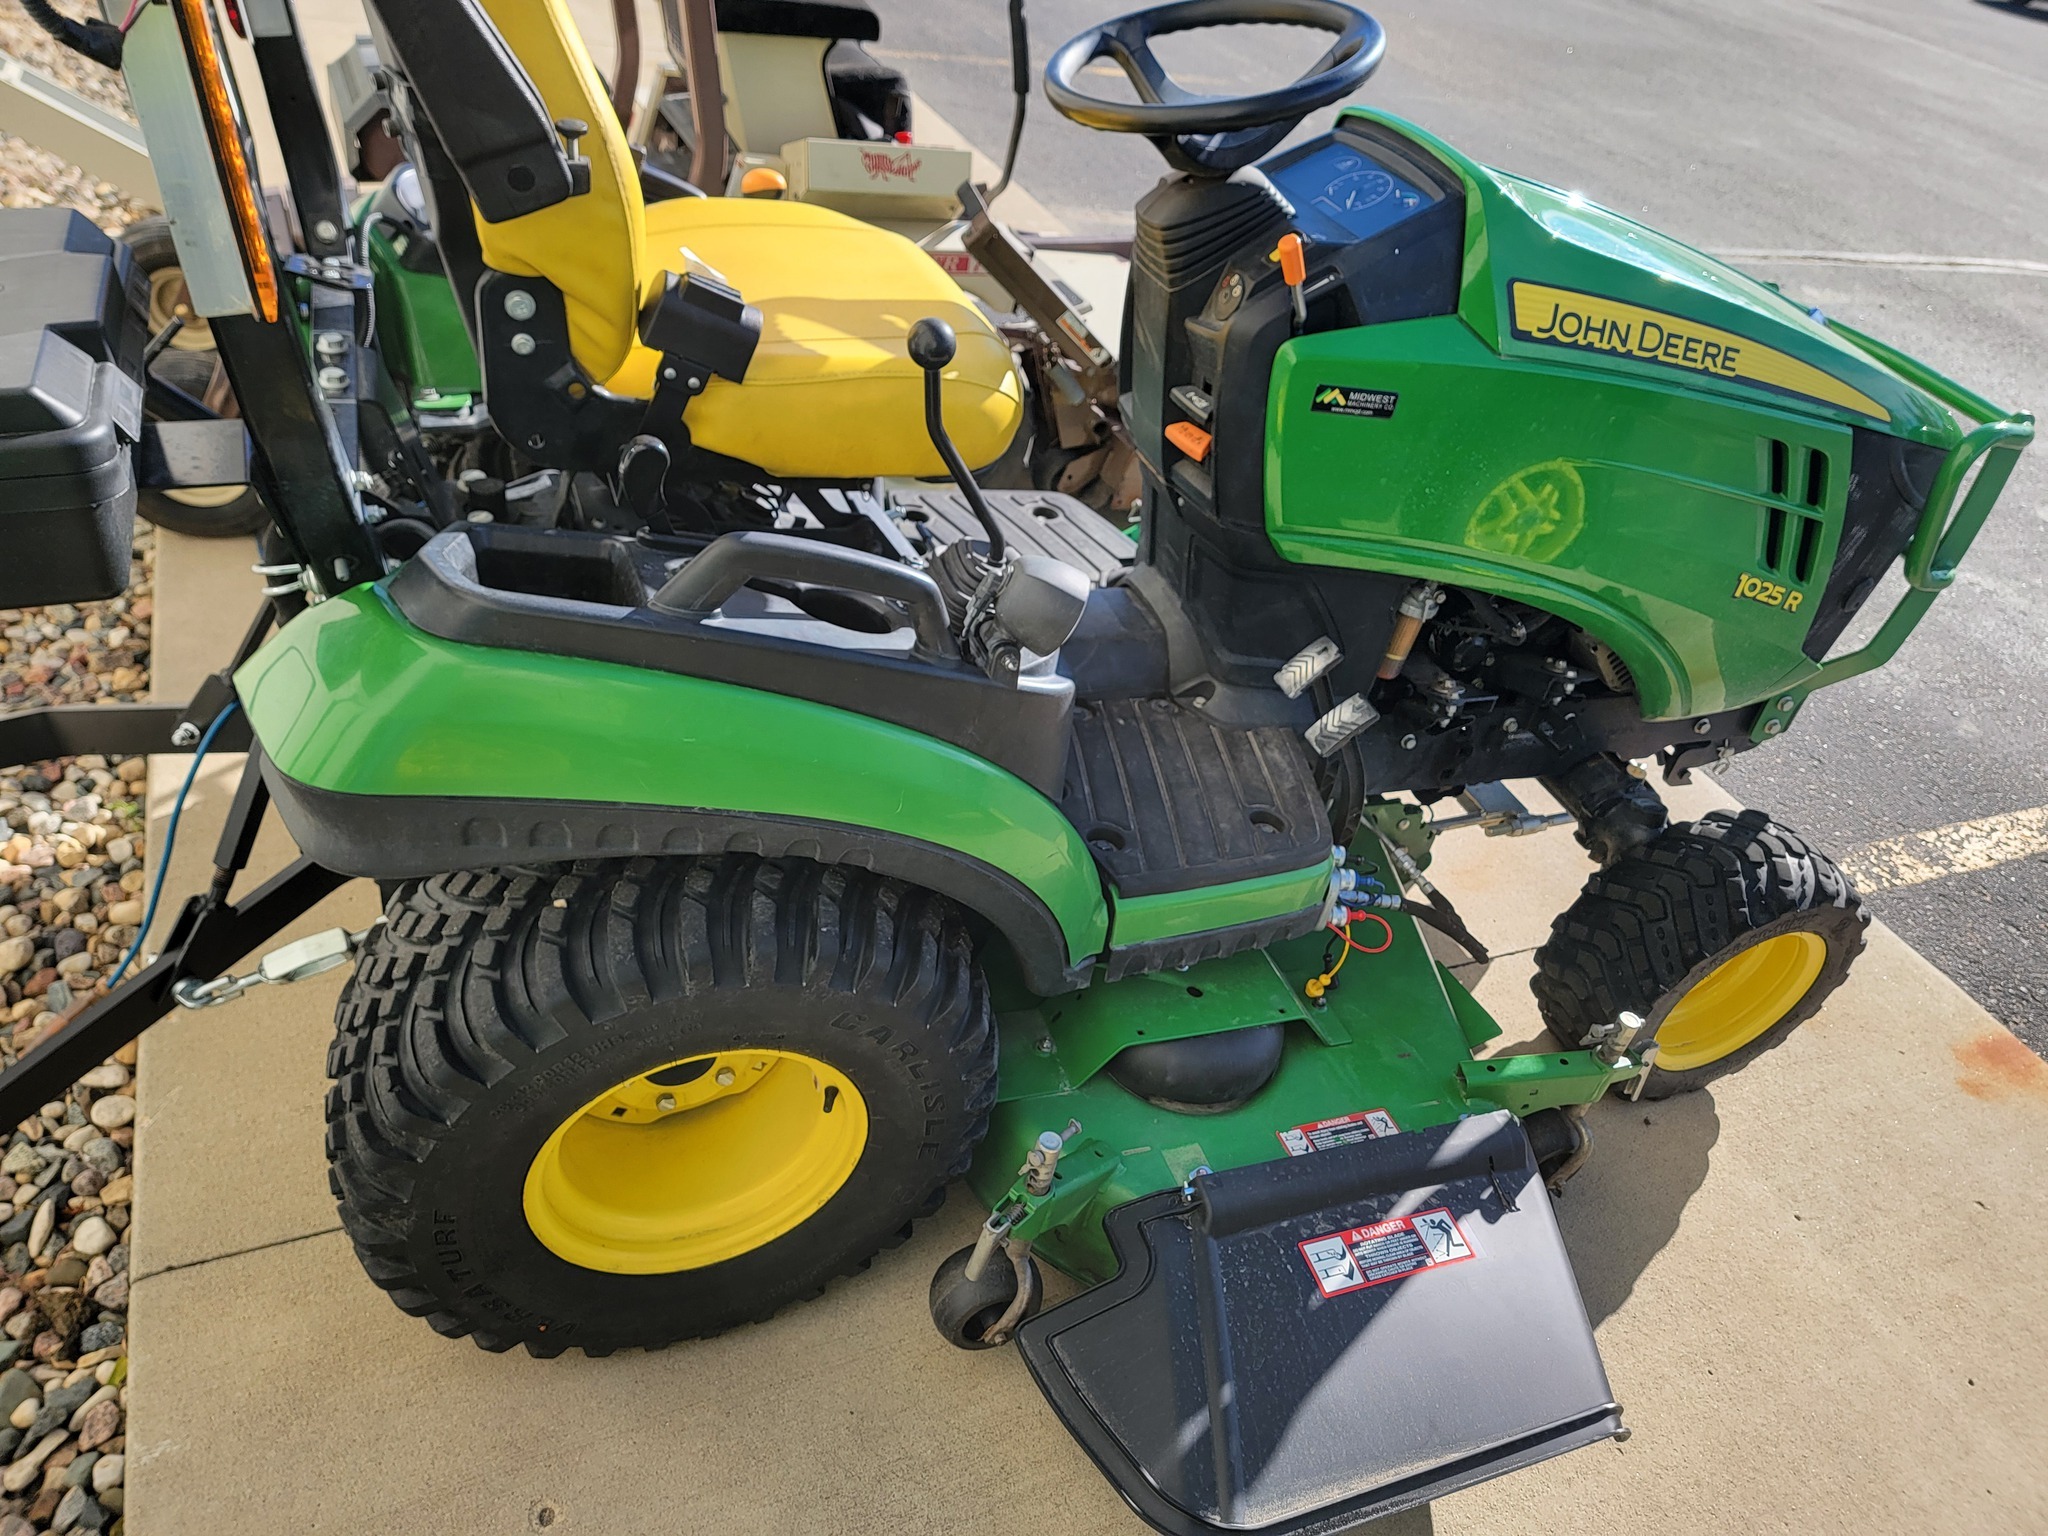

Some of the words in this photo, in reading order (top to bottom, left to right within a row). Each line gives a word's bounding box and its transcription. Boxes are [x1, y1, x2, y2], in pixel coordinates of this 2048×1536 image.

[1536, 303, 1631, 348] JOHN
[1637, 321, 1741, 372] DEERE
[1348, 391, 1397, 404] MIDWEST
[829, 1011, 946, 1160] CARLISLE
[433, 1209, 473, 1284] TURF
[1361, 1219, 1406, 1237] DANGER
